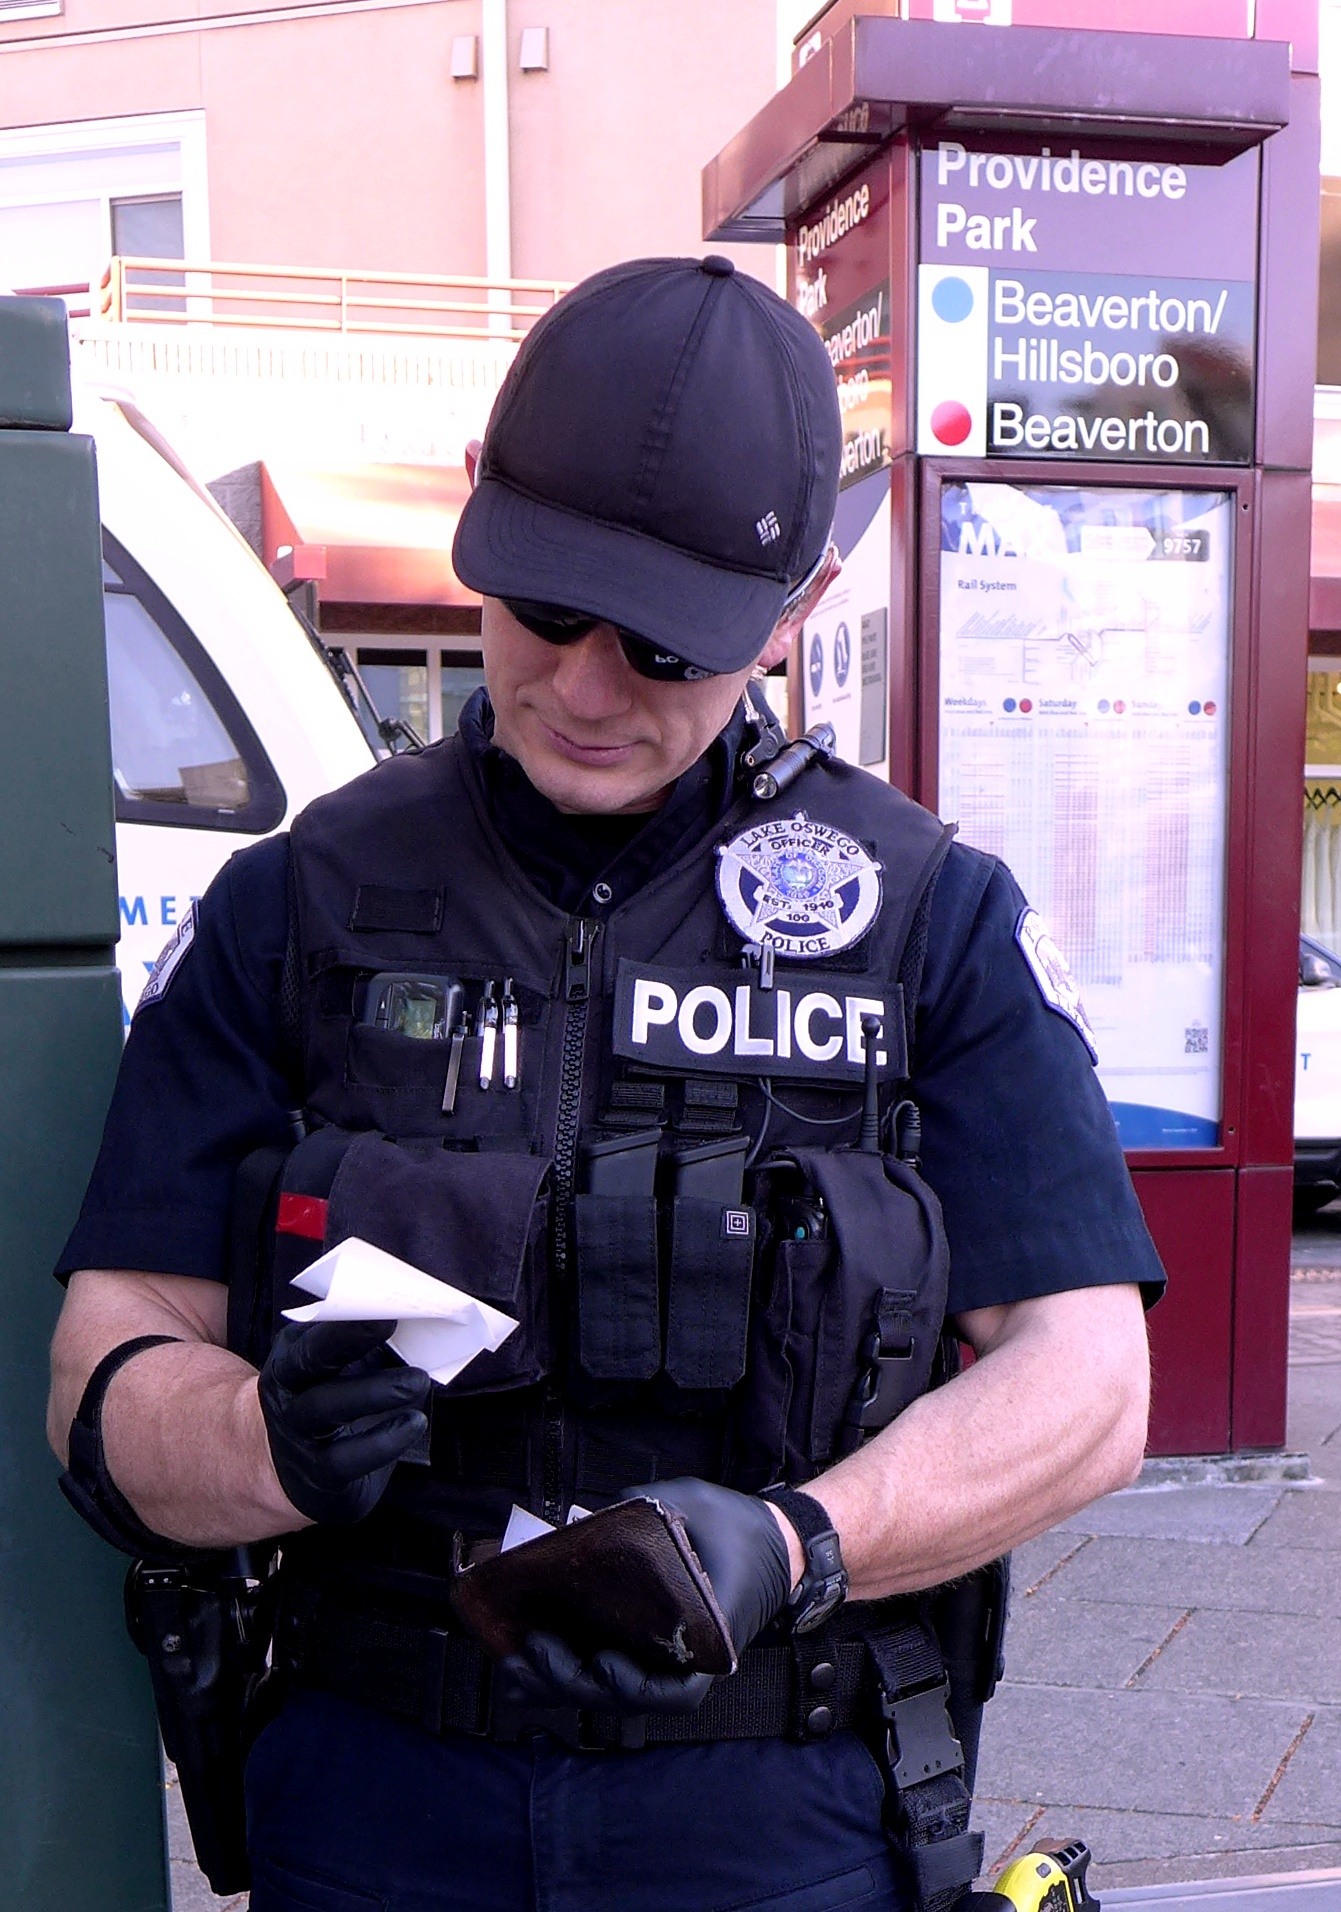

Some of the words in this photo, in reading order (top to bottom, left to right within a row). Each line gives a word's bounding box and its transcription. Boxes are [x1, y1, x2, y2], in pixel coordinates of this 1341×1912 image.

[937, 141, 1188, 199] Providence
[798, 183, 870, 267] Providence
[936, 203, 1038, 252] Park
[798, 267, 828, 318] Park
[994, 279, 1228, 334] Beaverton/
[994, 336, 1179, 388] Hillsboro
[992, 402, 1210, 454] Beaverton
[1163, 538, 1201, 555] 9757
[957, 579, 977, 590] Rail
[979, 579, 1017, 592] System
[1038, 699, 1077, 709] Saturday
[740, 822, 786, 848] LAKE
[790, 821, 860, 856] OSWEGO
[770, 838, 831, 857] OFFICER
[786, 913, 810, 922] 100
[760, 931, 831, 954] POLICE
[631, 978, 888, 1066] POLICE
